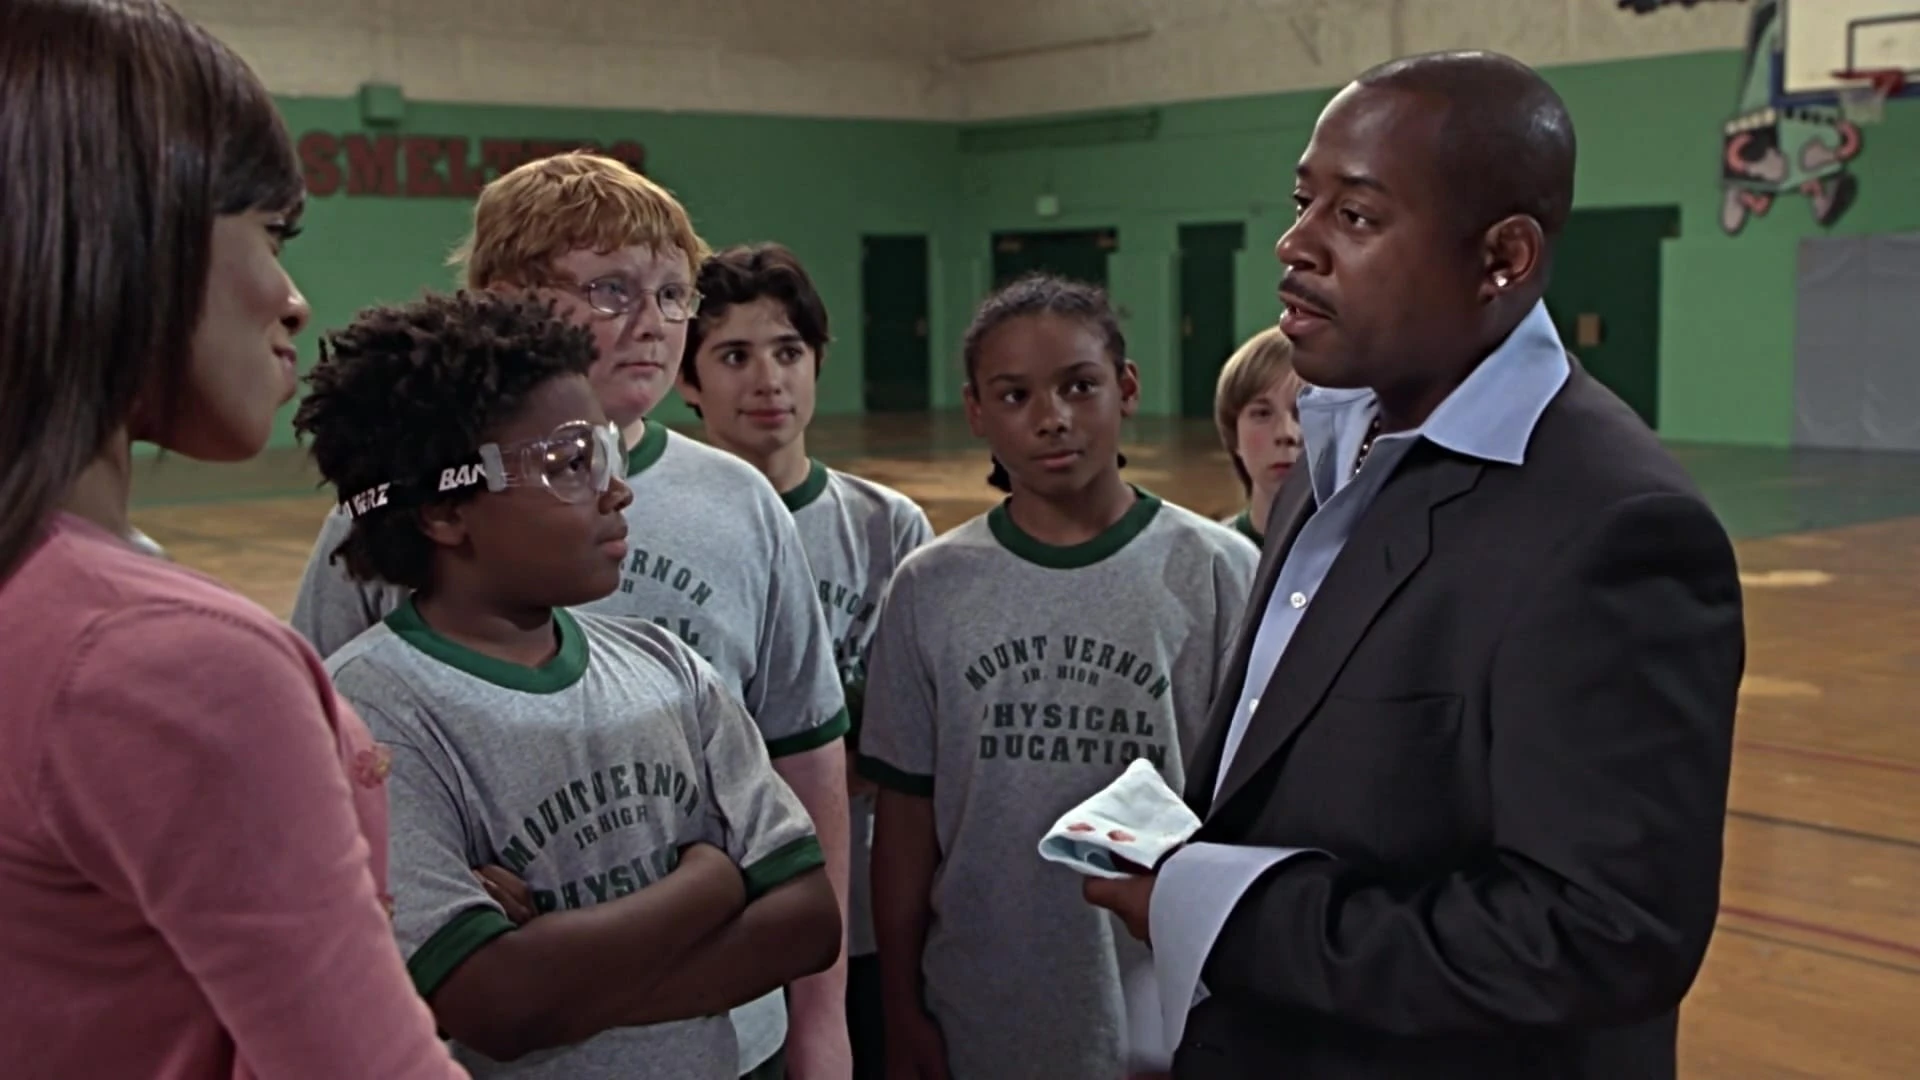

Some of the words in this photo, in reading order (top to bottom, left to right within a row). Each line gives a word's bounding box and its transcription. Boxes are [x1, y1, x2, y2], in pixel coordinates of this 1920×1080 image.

[630, 548, 713, 607] RNON
[819, 580, 875, 622] RNON
[964, 634, 1048, 691] MOUNT
[1063, 634, 1170, 700] VERNON
[1057, 664, 1100, 687] HIGH
[982, 702, 1154, 736] HYSICAL
[979, 734, 1167, 770] DUCATION
[502, 779, 591, 873] MOUNT
[598, 804, 649, 834] HIGH
